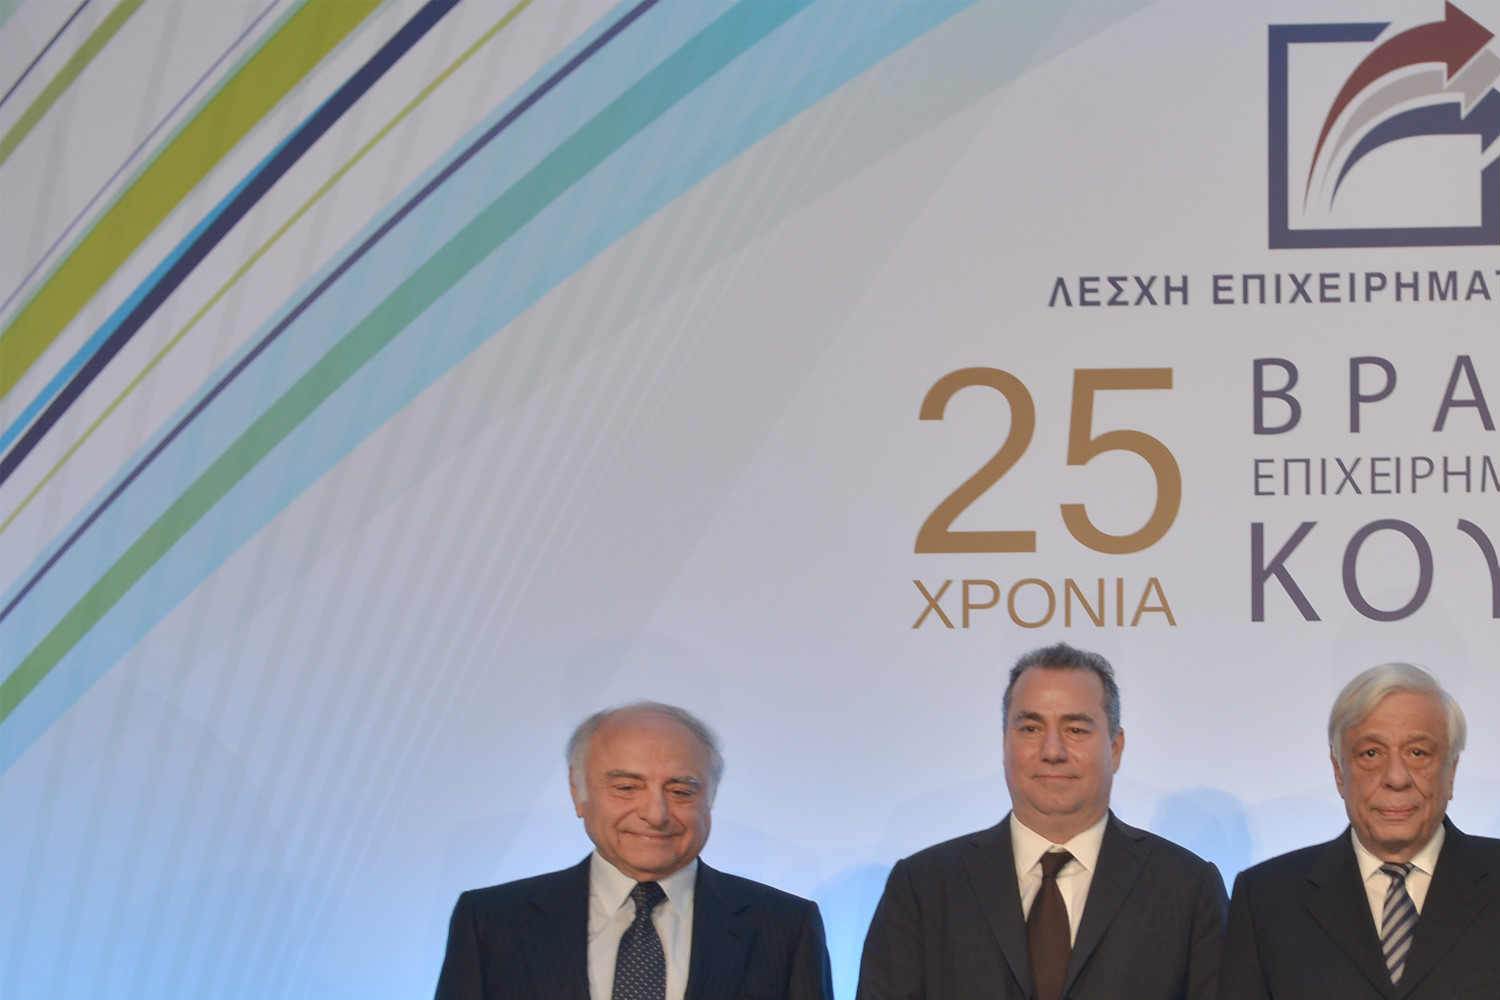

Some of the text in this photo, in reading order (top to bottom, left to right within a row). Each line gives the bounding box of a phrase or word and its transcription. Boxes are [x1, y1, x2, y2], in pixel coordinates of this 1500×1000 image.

[1048, 275, 1189, 307] ΛΕΣΧΗ
[914, 366, 1183, 555] 25
[912, 577, 1177, 629] ΧΡΟΝΙΑ
